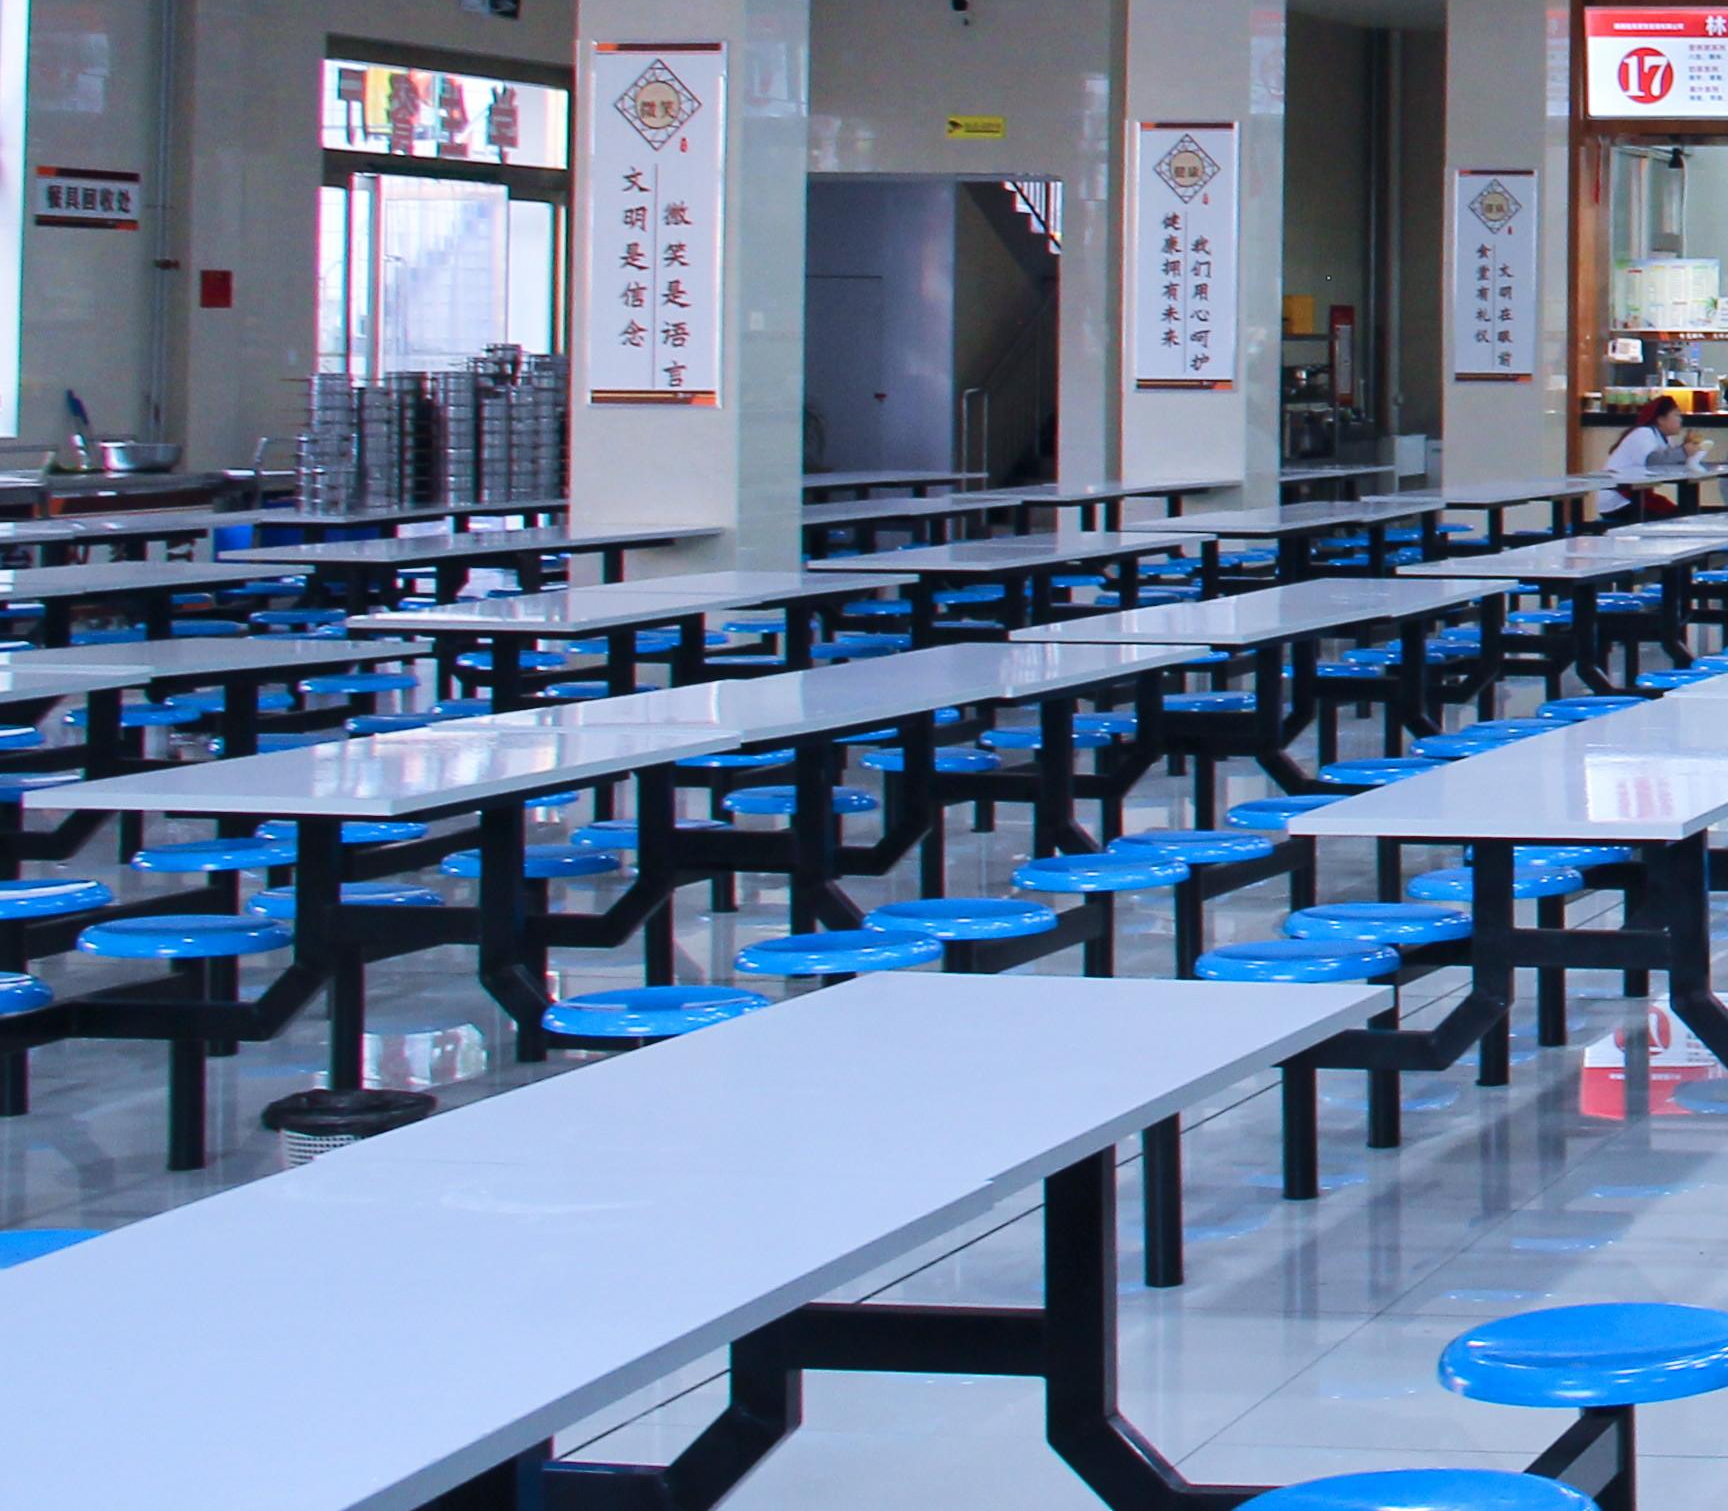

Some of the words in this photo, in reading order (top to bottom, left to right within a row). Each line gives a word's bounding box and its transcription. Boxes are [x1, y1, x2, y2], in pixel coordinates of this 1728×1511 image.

[640, 99, 677, 120] 微笑
[1623, 55, 1669, 97] 17
[47, 185, 131, 214] 餐具回收处
[618, 165, 652, 348] 文明是信念
[661, 200, 692, 388] 微笑是语言
[1160, 211, 1183, 348] 健康拥有未来
[1190, 235, 1213, 372] 我们用心呵护
[1497, 262, 1514, 368] 文明在眼前
